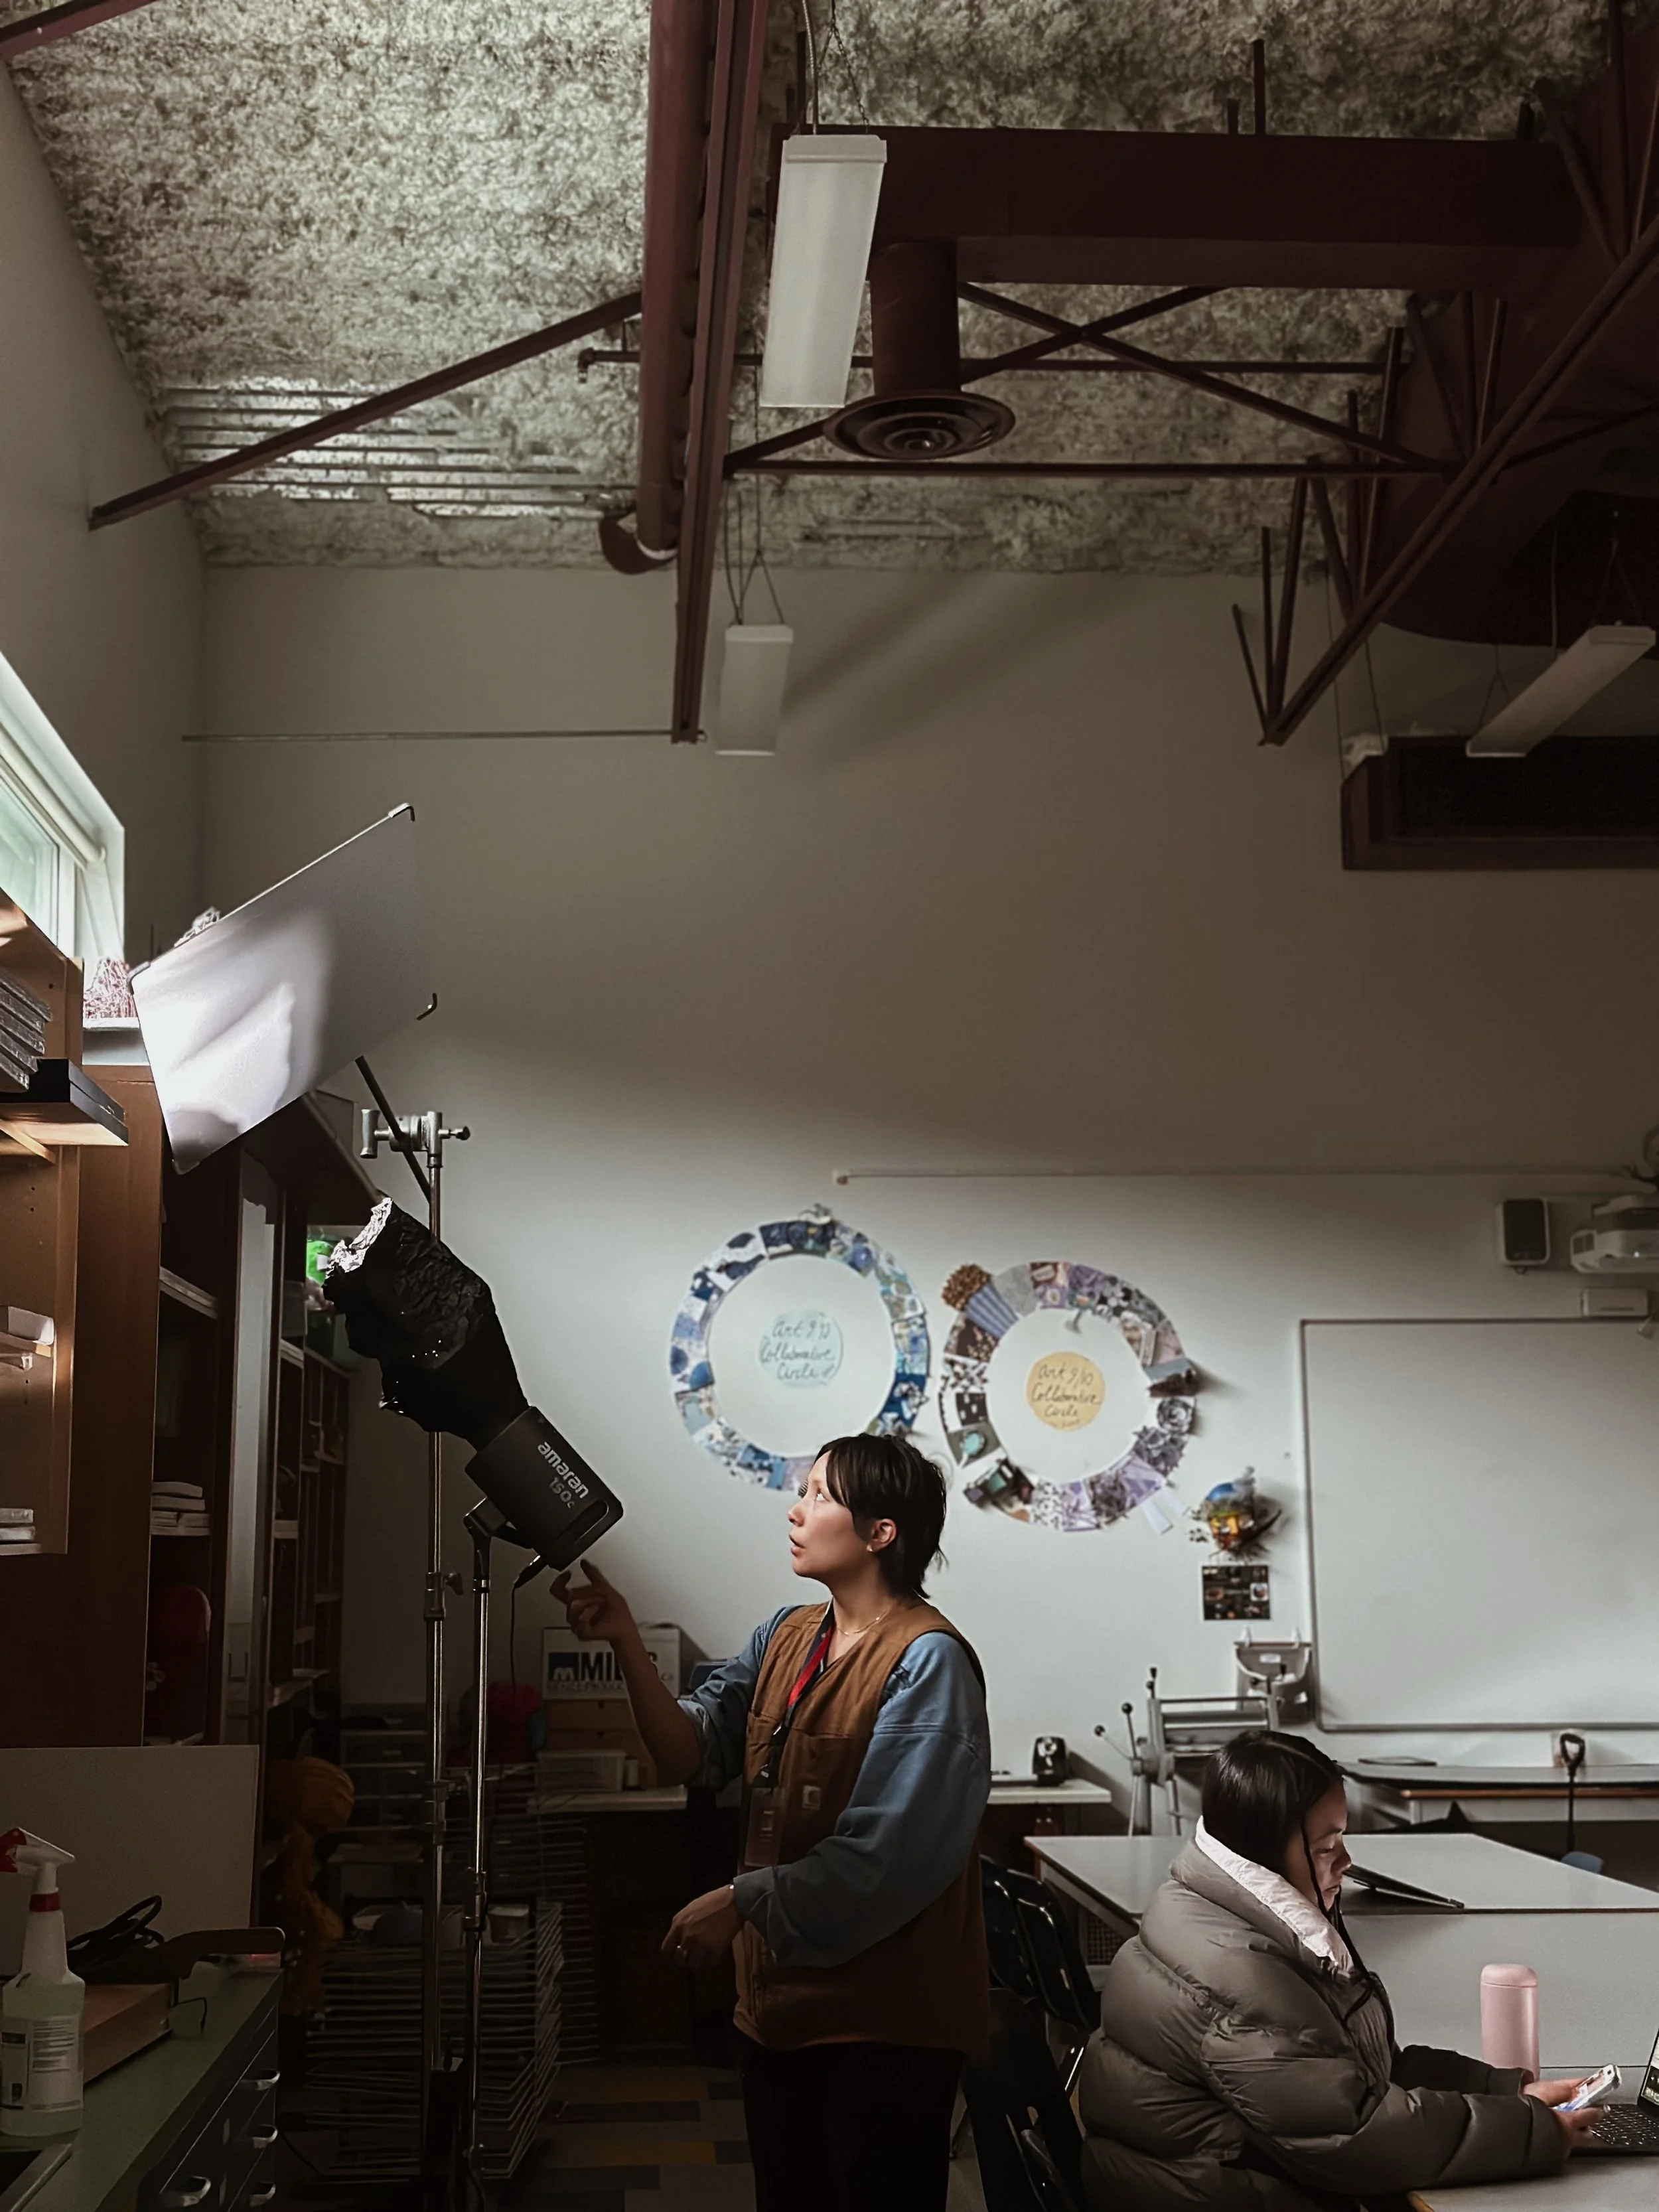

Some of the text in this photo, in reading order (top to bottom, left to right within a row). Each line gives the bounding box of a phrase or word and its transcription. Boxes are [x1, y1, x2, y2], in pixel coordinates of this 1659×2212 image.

[1031, 1382, 1102, 1405] Collaborative
[537, 1441, 589, 1499] amaran
[549, 1477, 575, 1509] 150c
